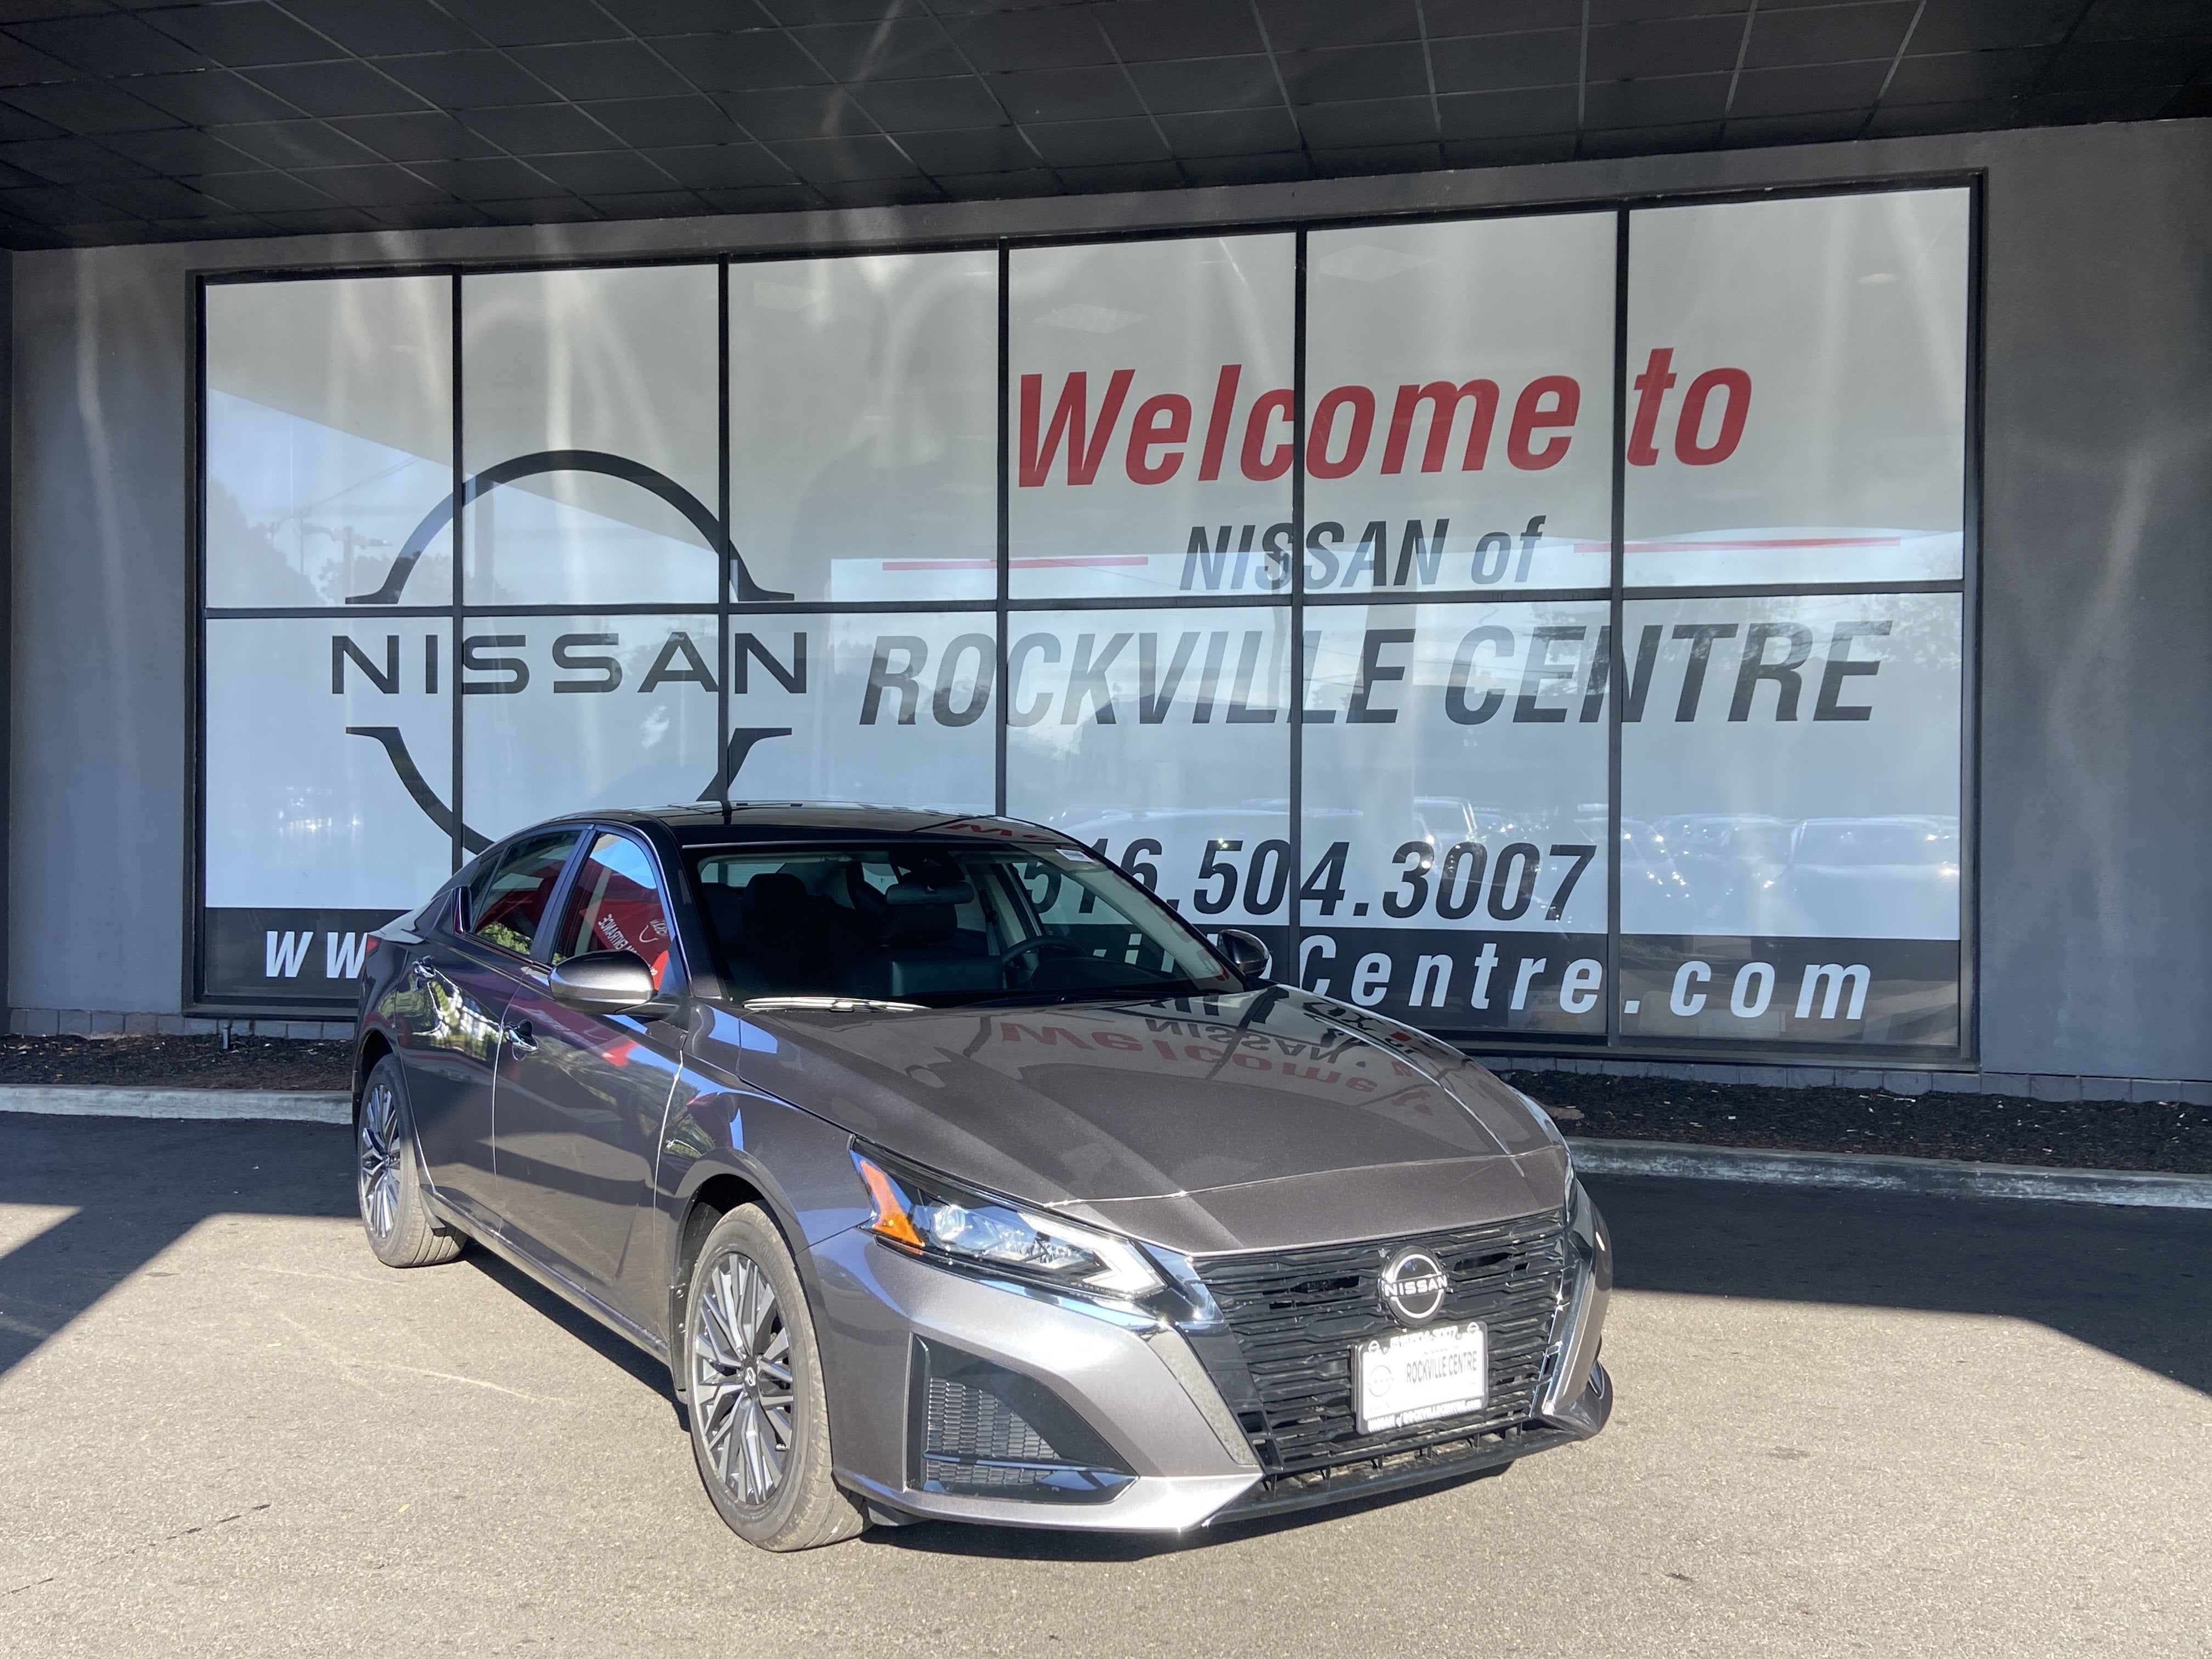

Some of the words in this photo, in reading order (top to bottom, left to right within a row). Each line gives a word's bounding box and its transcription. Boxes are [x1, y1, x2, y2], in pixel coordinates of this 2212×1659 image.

[1018, 364, 1582, 488] Welcome
[1627, 348, 1753, 467] to
[1178, 518, 1449, 591] NISSAN
[1471, 515, 1547, 585] of
[332, 631, 807, 695] NISSAN
[859, 626, 1416, 726] ROCKVILLE
[1443, 619, 1893, 725] CENTRE
[1384, 1274, 1447, 1297] NISSAN
[1407, 1356, 1447, 1384] ROCKVILLE
[1449, 1351, 1477, 1376] CENTRE
